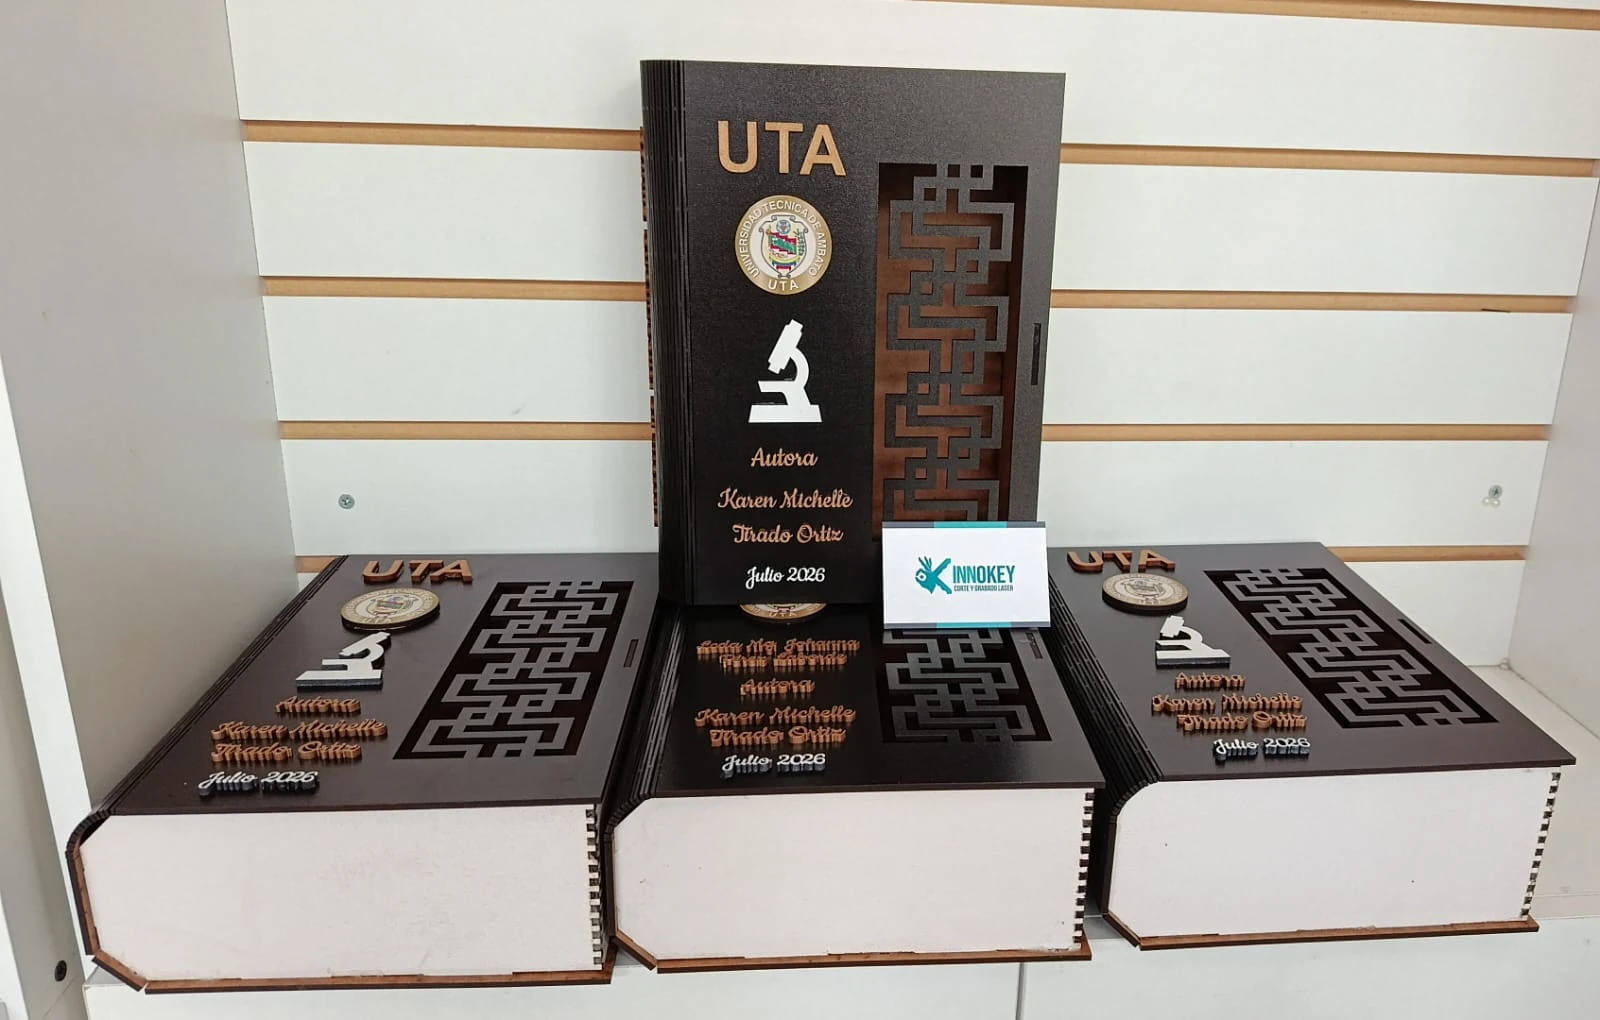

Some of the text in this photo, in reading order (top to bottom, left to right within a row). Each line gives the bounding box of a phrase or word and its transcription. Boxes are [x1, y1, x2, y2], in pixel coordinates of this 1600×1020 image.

[717, 120, 847, 177] UTA
[739, 199, 826, 278] UNIVERSIDAD TECNICA DE AMBATO
[768, 278, 800, 291] UTA
[750, 447, 819, 467] Autora
[717, 486, 854, 509] Karen Michelle
[732, 524, 844, 544] Tirado Ortiz
[362, 559, 473, 583] UTA
[1067, 549, 1176, 572] UTA
[745, 566, 826, 590] Julio 2026
[952, 565, 1016, 584] INNOKEY
[740, 678, 816, 696] Autora
[1174, 672, 1246, 689] Autora
[275, 695, 361, 713] Autora
[1152, 692, 1304, 712] Karen Michelle
[695, 705, 857, 728] Karen Michelle
[1176, 711, 1308, 731] Tirado Ortiz
[211, 717, 388, 740] Karen Michelle
[710, 725, 847, 747] Tirado Ortiz
[211, 740, 362, 762] Tirado Ortiz
[1213, 737, 1311, 758] Julio 2026
[721, 752, 826, 775] Julio 2026
[198, 771, 319, 792] Julio 2026
